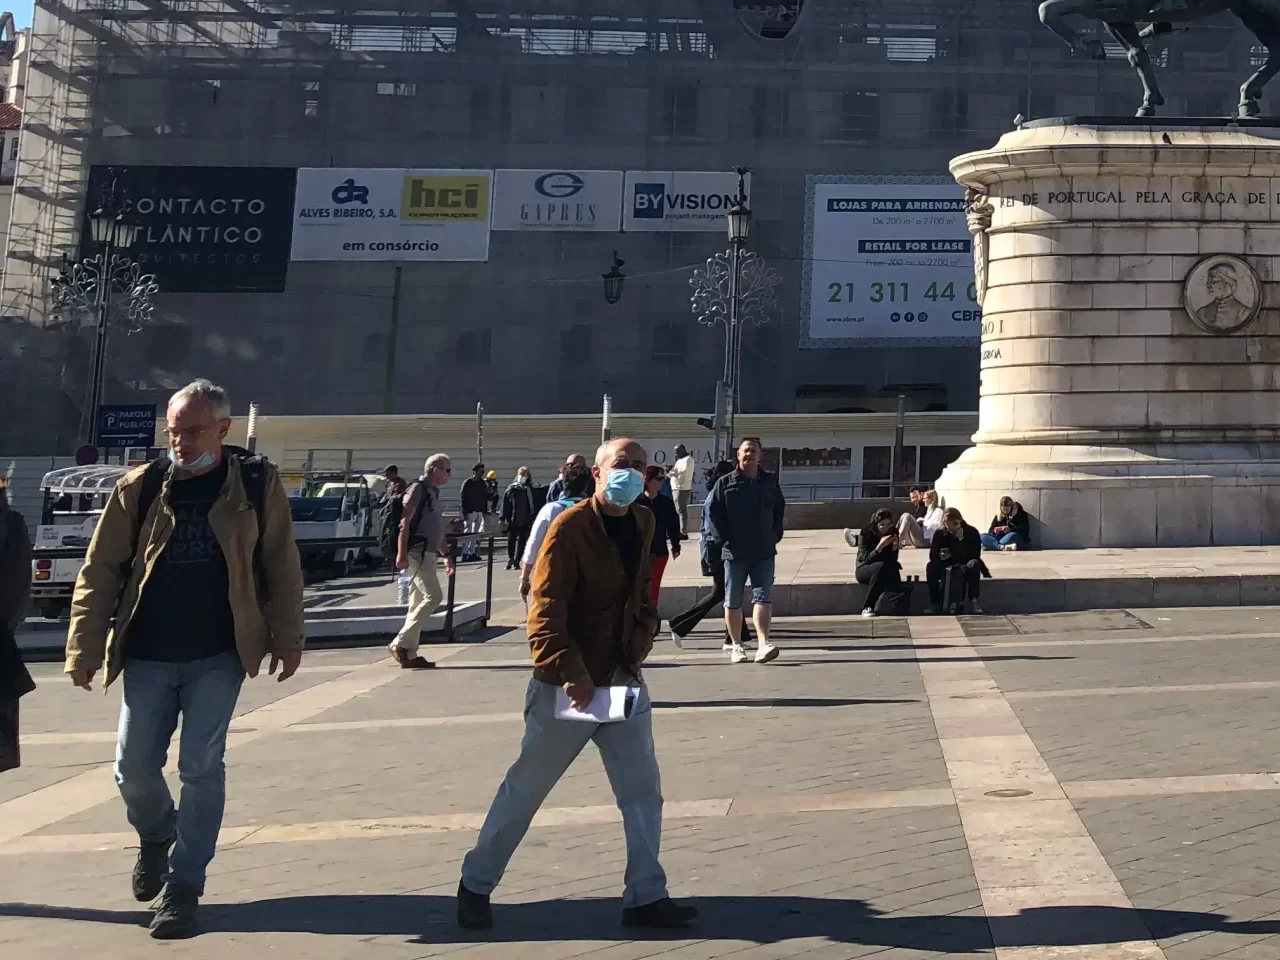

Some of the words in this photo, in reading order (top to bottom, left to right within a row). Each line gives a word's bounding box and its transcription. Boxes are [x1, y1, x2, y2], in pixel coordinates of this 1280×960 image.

[1023, 193, 1039, 205] DE
[1048, 191, 1126, 204] PORTUGAL
[1136, 191, 1171, 204] PELA
[1182, 192, 1237, 206] GRAÇA
[1248, 192, 1266, 204] DE
[833, 201, 868, 211] LOJAS
[871, 201, 902, 211] PARA
[299, 207, 331, 219] ALVES
[333, 207, 376, 220] RIBEIRO,
[379, 207, 398, 219] S.A.
[872, 217, 885, 226] De
[887, 217, 901, 226] 200
[923, 217, 945, 226] 2700
[133, 223, 263, 244] TLÂNTICO
[342, 242, 365, 252] em
[368, 239, 440, 252] consórcio
[864, 242, 902, 251] RETAIL
[905, 242, 928, 251] FOR
[931, 242, 964, 251] LEASE
[135, 253, 261, 265] QUITECTOS
[827, 282, 855, 303] 21
[869, 282, 910, 302] 311
[922, 281, 956, 302] 44
[119, 420, 154, 429] PÚBLICO
